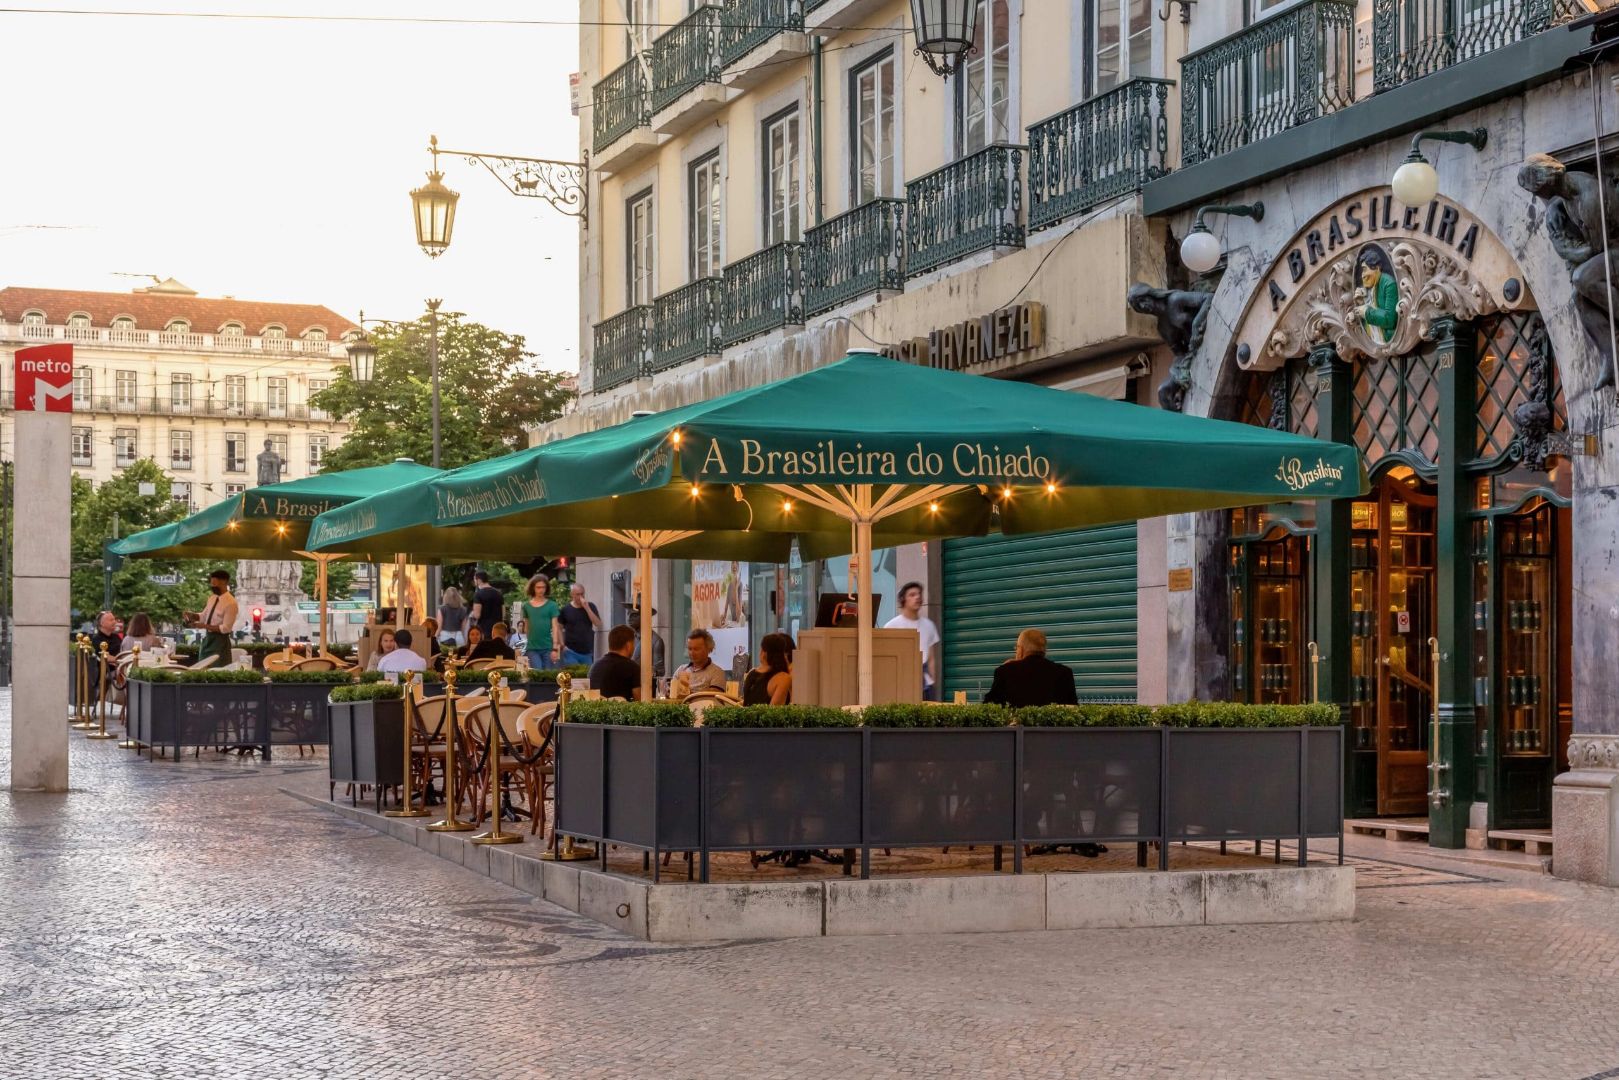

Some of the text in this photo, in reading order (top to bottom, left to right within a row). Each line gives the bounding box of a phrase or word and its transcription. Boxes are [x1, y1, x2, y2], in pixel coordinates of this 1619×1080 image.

[1268, 195, 1479, 312] A BRASILEIRA
[928, 301, 1041, 371] HAVANEZA
[21, 359, 71, 373] metro
[700, 437, 1050, 478] A Brasileira do Chiado
[1287, 458, 1342, 490] Brasileira
[253, 497, 345, 517] A Brasil
[436, 490, 447, 519] A
[447, 486, 498, 517] Brasileira
[494, 481, 512, 507] do
[694, 582, 720, 600] AGORA
